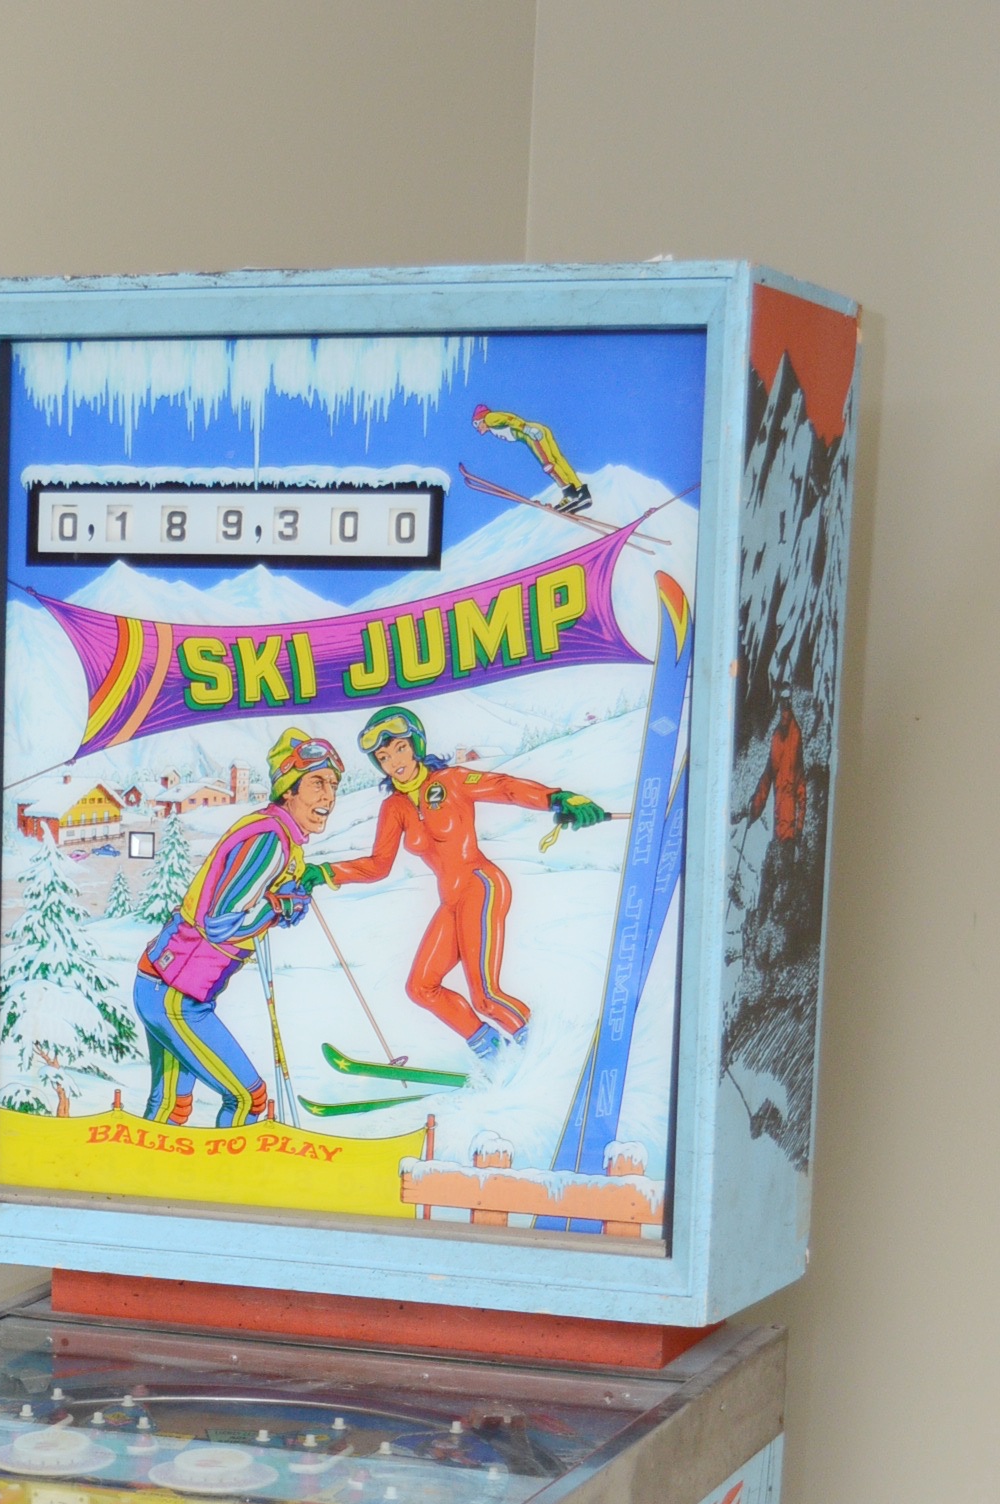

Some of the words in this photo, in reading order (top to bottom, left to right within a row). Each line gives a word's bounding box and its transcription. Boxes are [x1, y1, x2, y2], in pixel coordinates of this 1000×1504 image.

[177, 631, 318, 711] SKI
[342, 563, 588, 699] JUMP
[609, 885, 643, 1042] JUMP
[86, 1123, 196, 1156] BALLS
[205, 1135, 248, 1155] TO
[256, 1133, 343, 1163] PLAY
